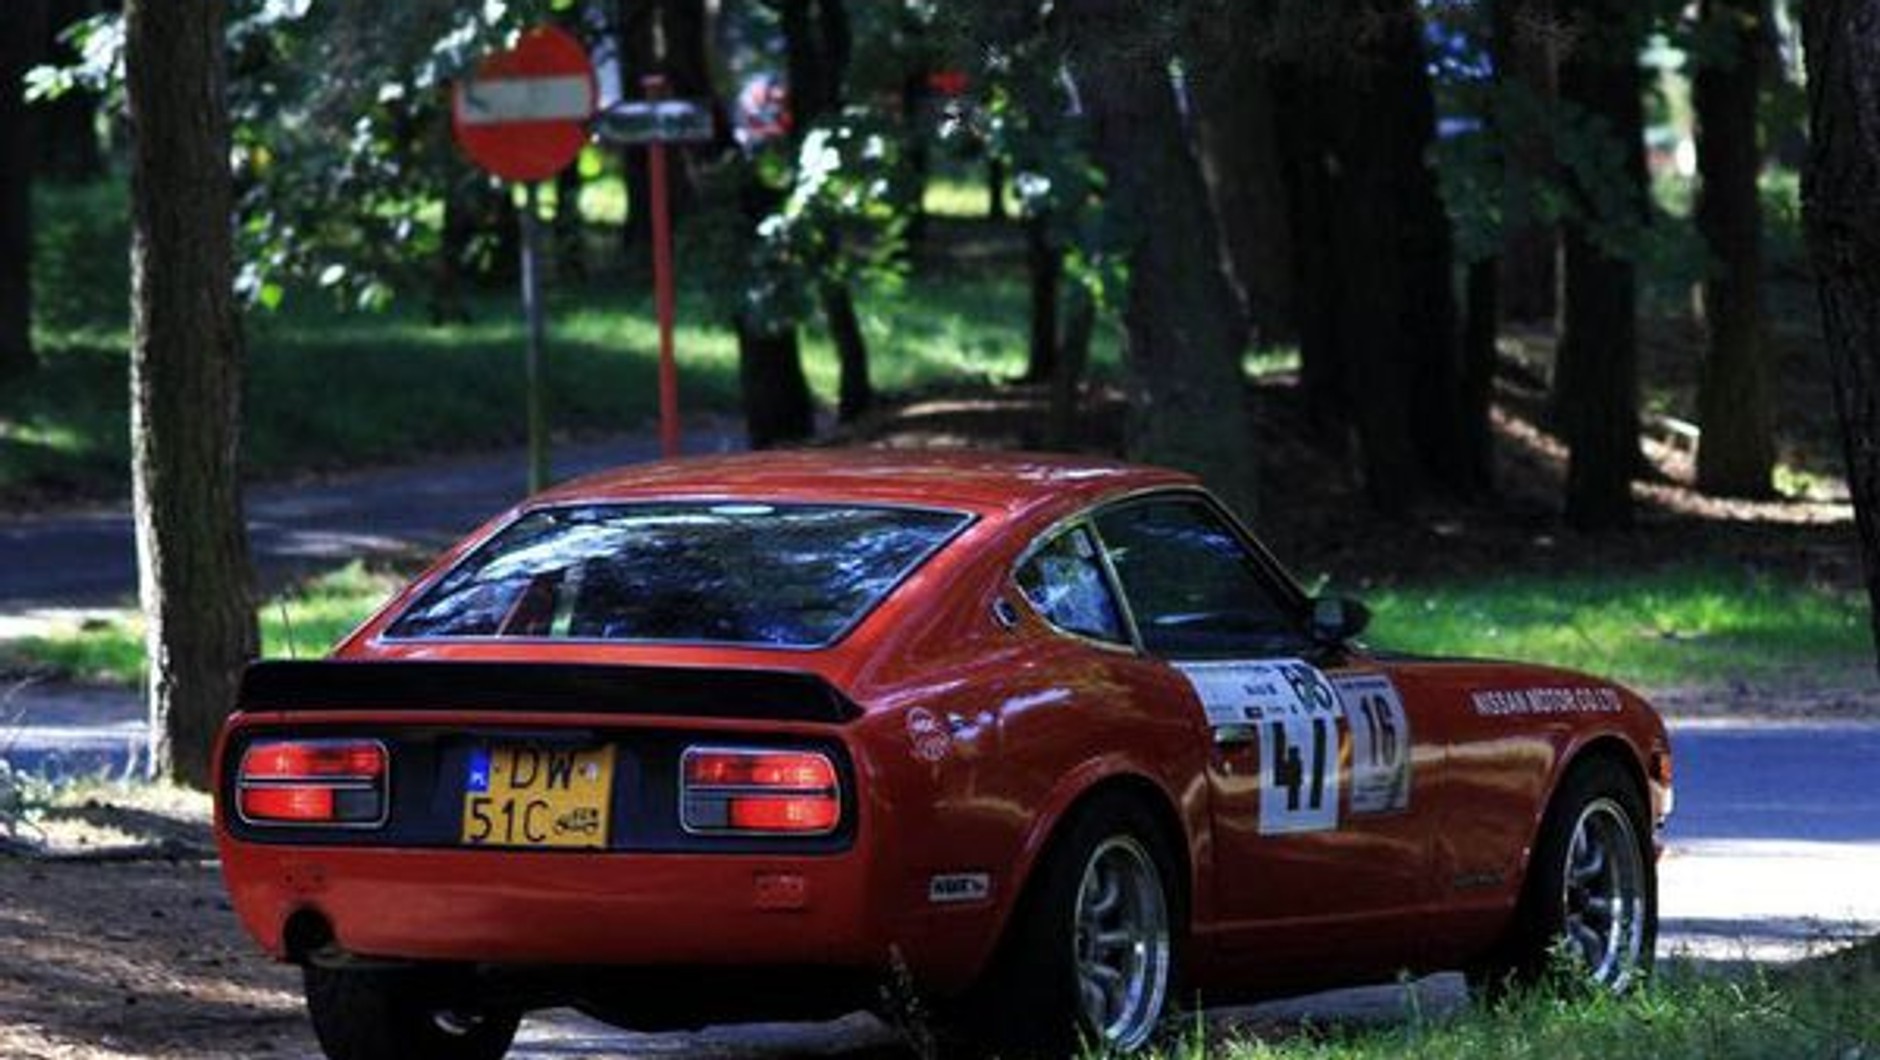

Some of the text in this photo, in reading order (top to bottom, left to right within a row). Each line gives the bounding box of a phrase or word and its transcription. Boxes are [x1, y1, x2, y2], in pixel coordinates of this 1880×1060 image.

[1472, 690, 1530, 715] NISSAN
[1526, 688, 1575, 713] MOTOR
[1361, 694, 1397, 768] 16
[509, 749, 575, 789] DW
[469, 798, 549, 842] 51C
